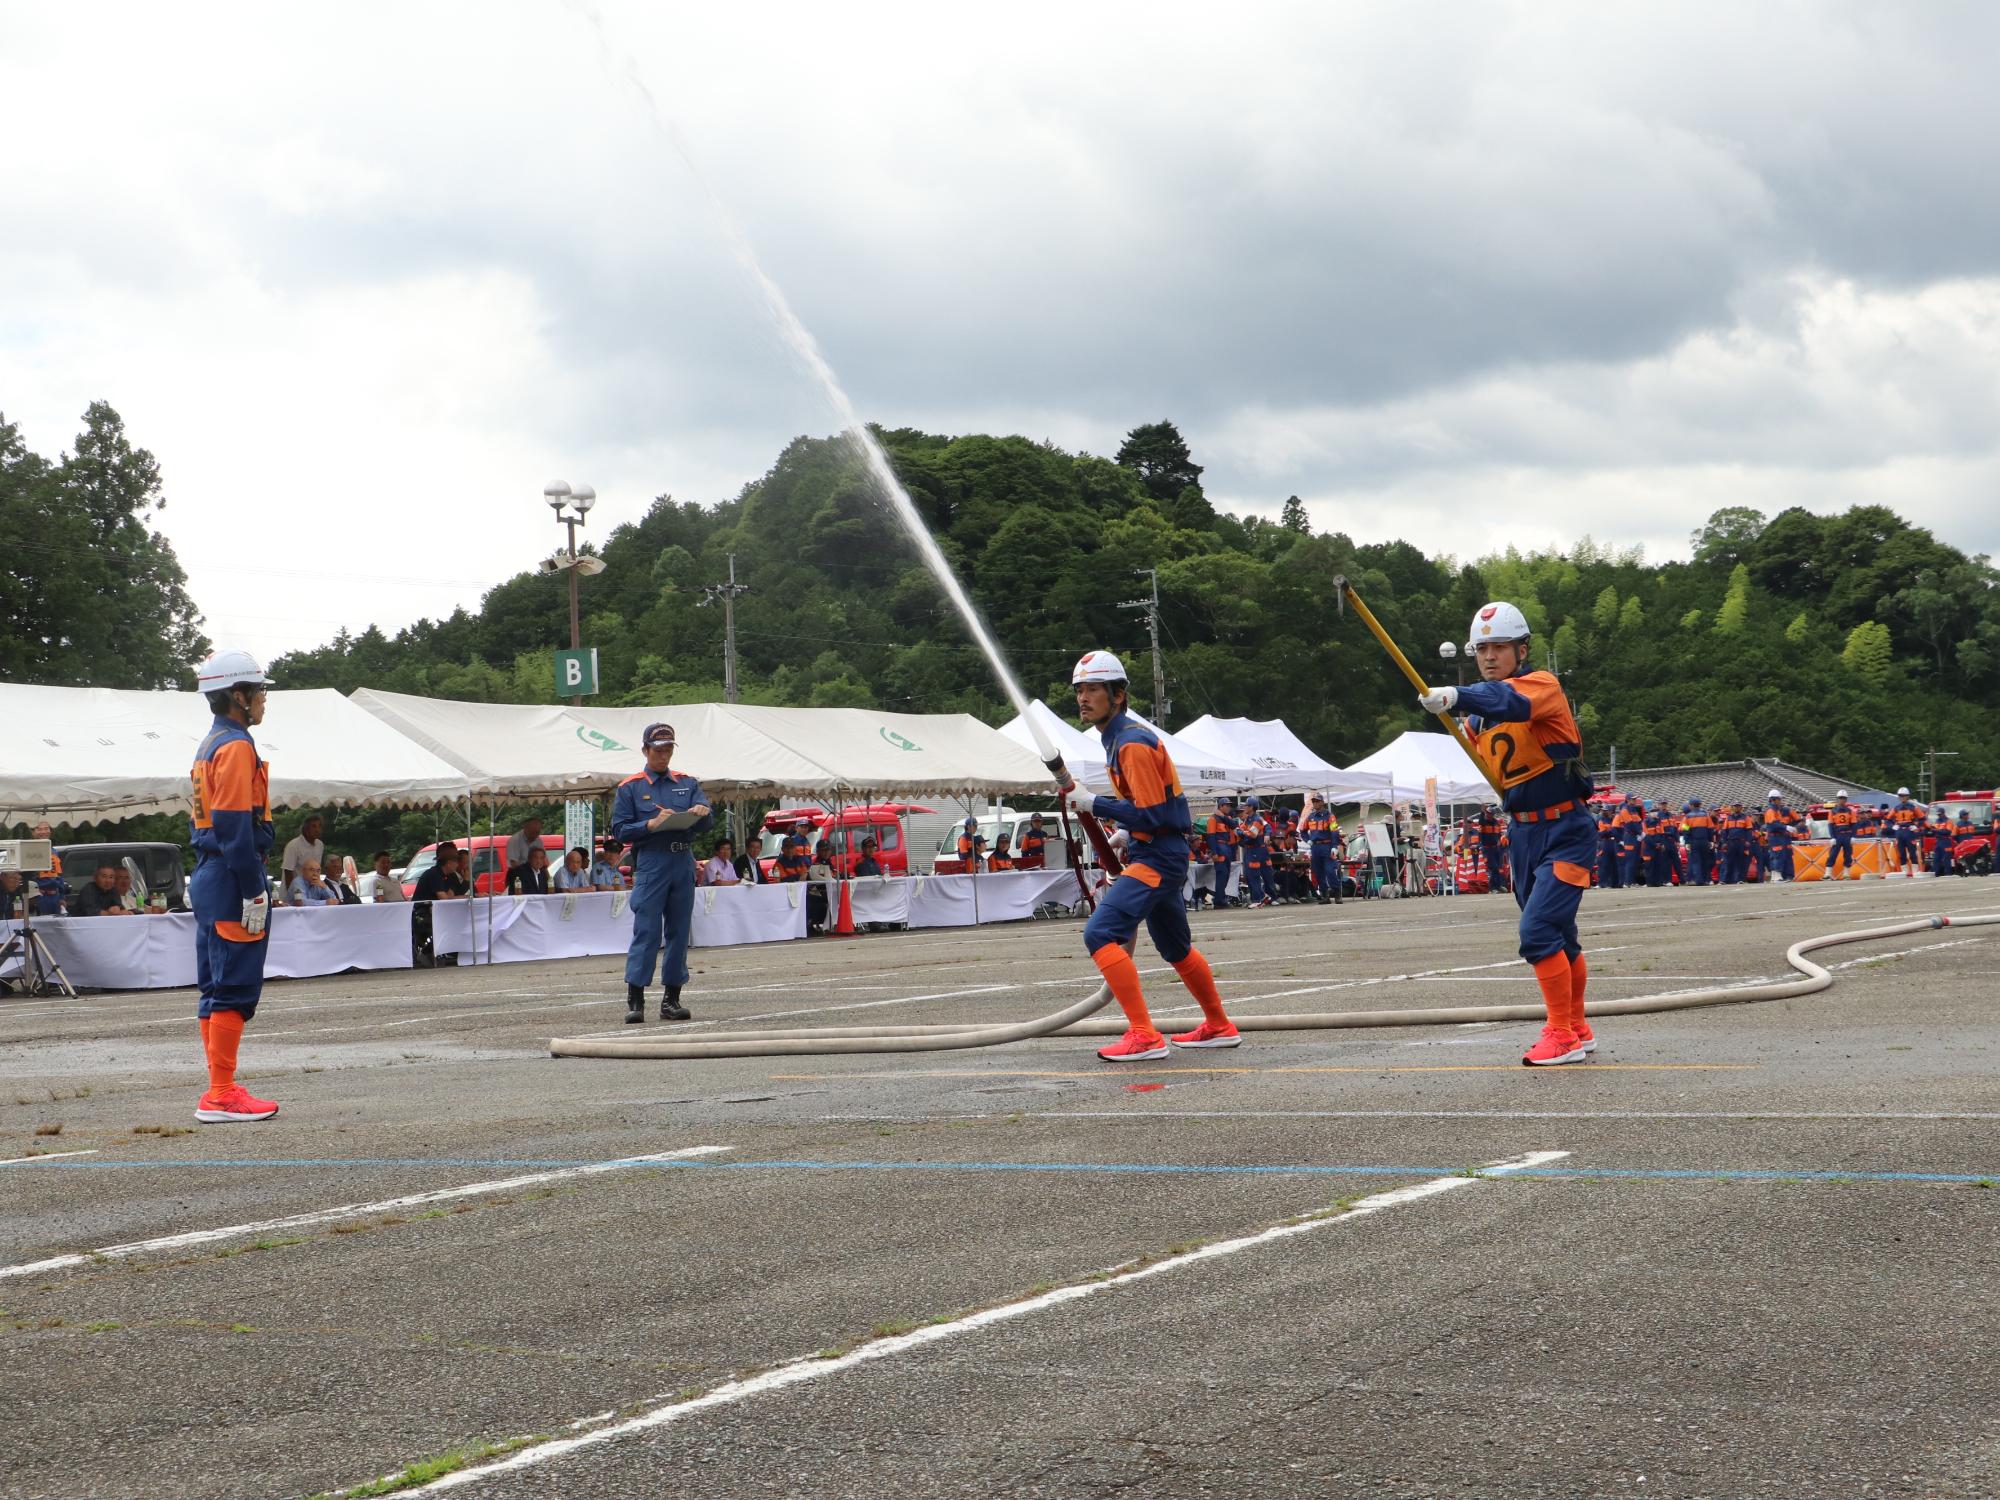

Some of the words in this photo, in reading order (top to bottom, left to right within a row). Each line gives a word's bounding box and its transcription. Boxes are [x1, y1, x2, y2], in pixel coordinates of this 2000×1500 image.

[566, 658, 582, 686] B
[1490, 732, 1531, 780] 2
[1839, 814, 1847, 823] 3
